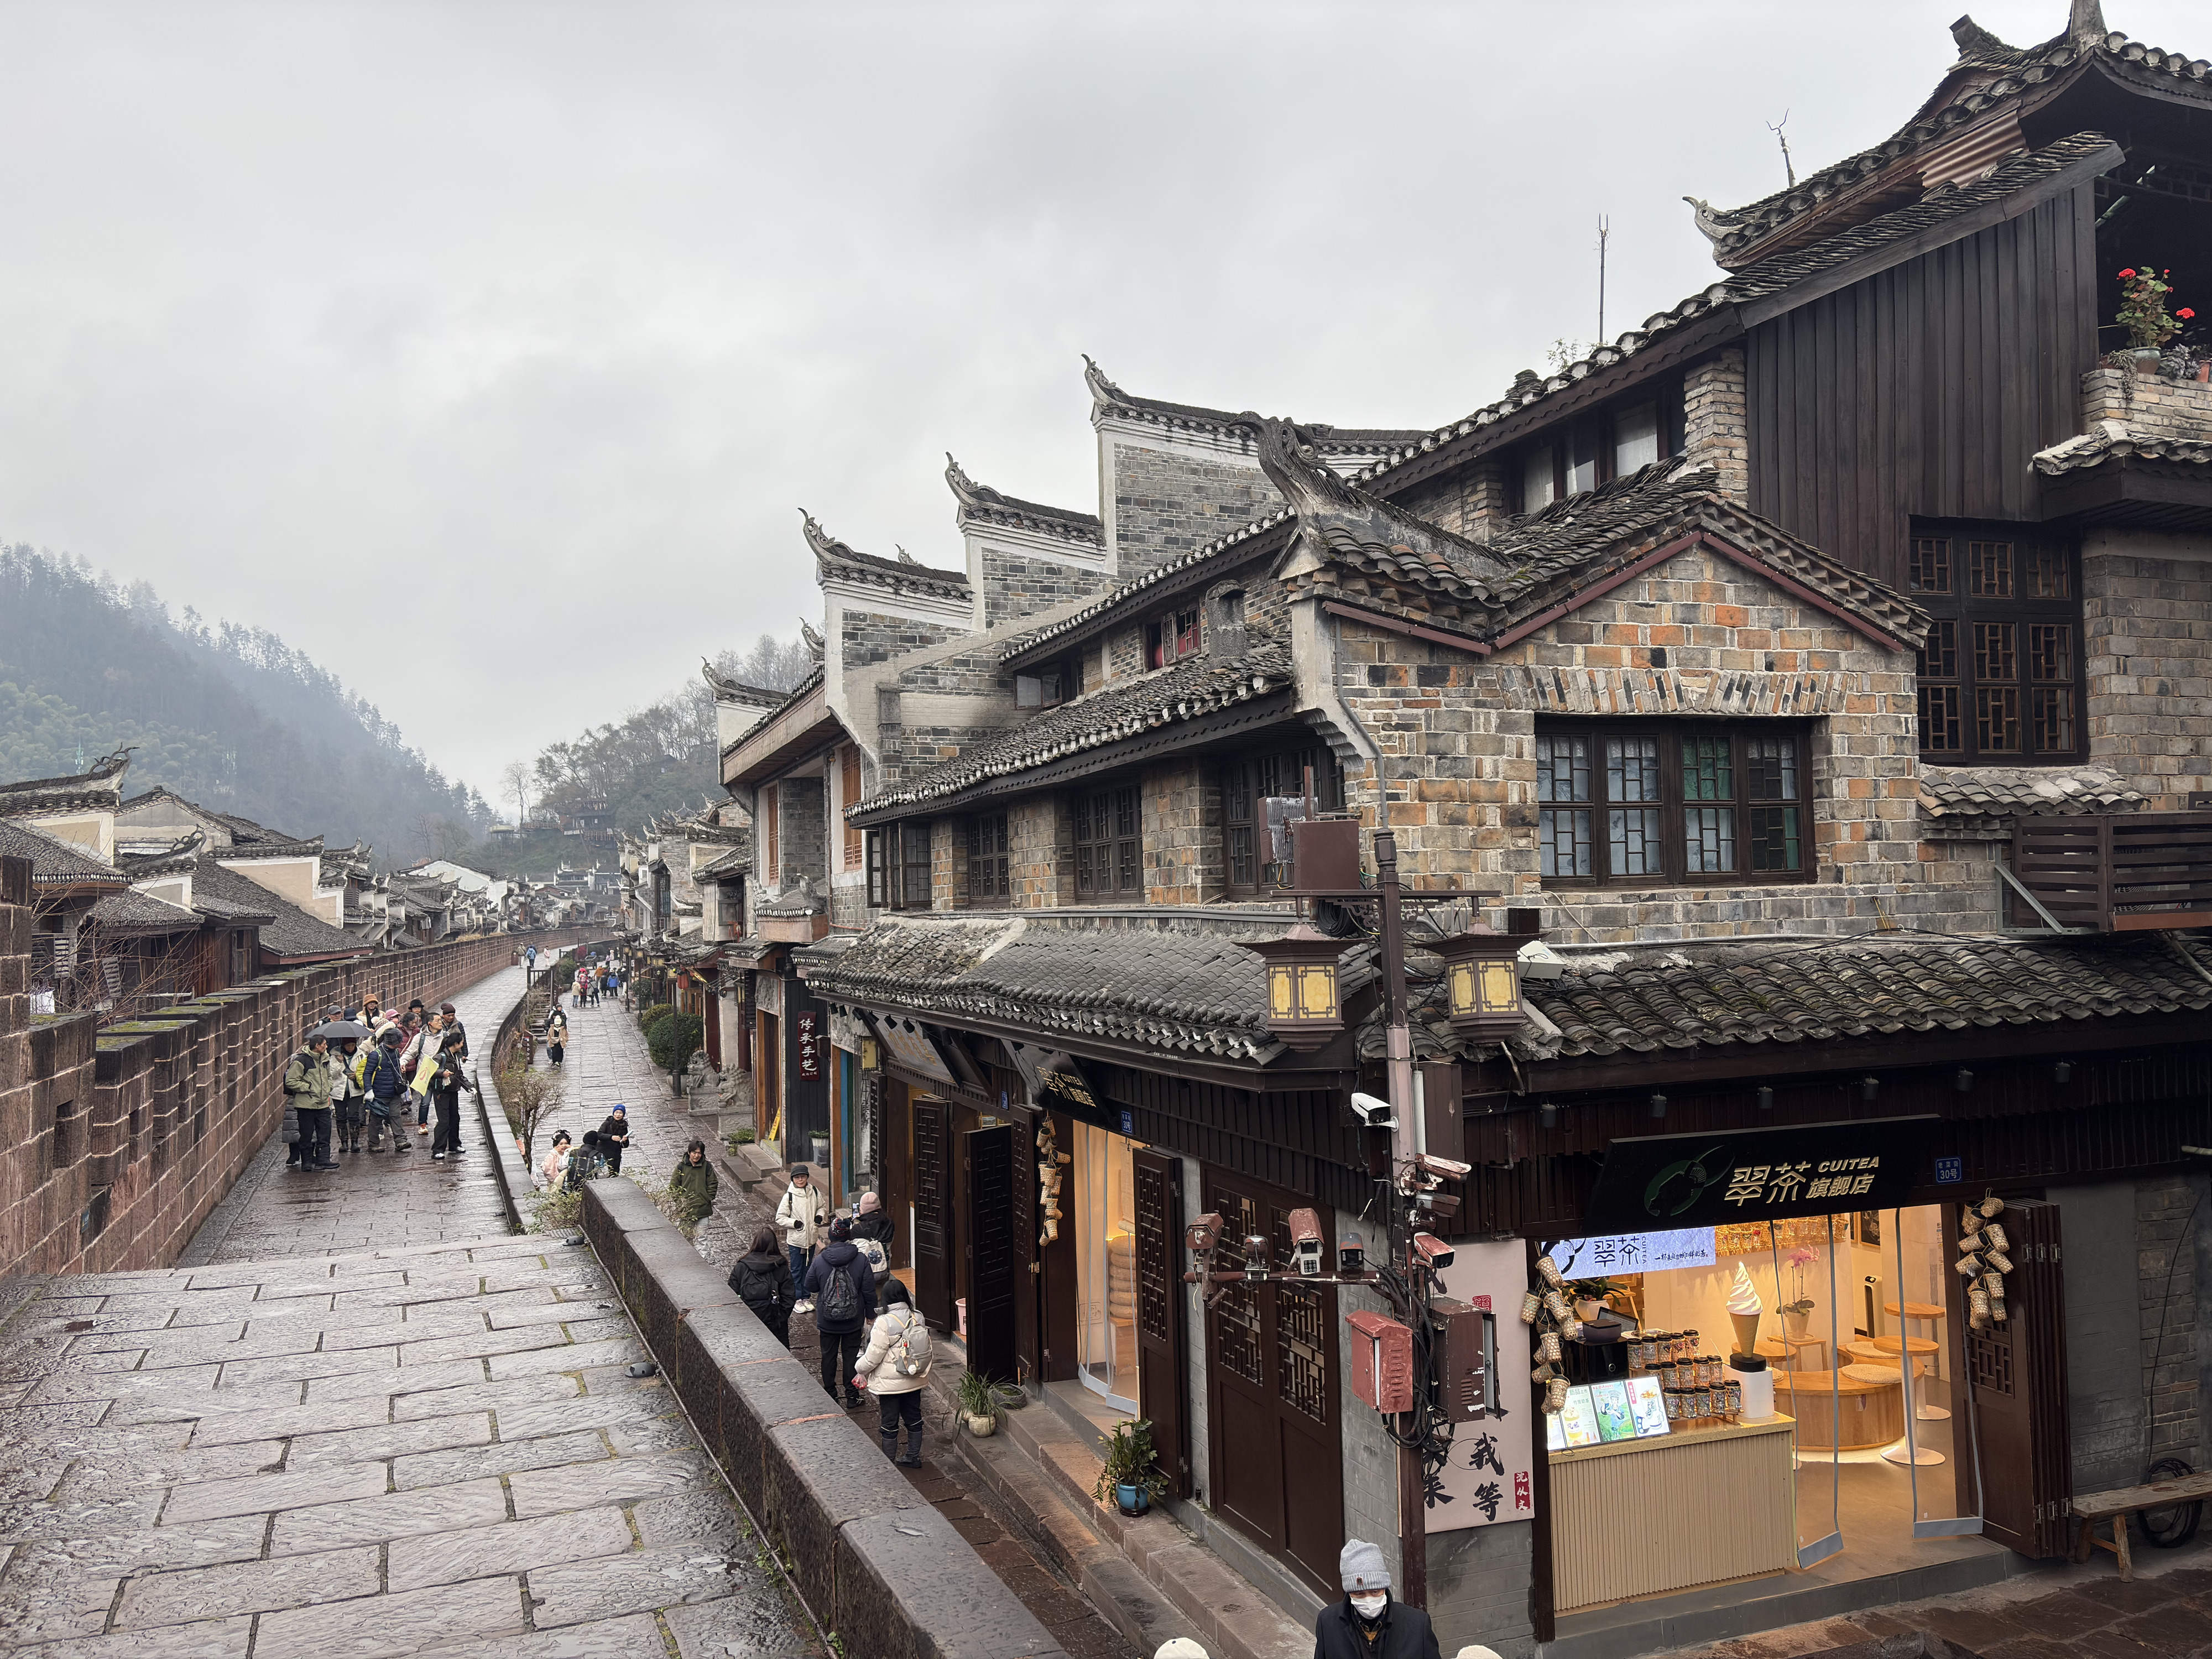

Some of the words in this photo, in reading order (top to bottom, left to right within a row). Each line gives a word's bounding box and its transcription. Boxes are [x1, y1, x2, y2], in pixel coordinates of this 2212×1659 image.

[799, 1018, 817, 1071] 传承手艺
[1036, 1066, 1074, 1101] 翠茶
[1060, 1073, 1084, 1087] CUITEA
[1818, 1156, 1879, 1172] CUITEA
[1940, 1168, 1958, 1179] 30号
[1724, 1160, 1811, 1206] 翠茶
[1806, 1173, 1875, 1199] 旗舰店
[1594, 1236, 1640, 1267] 翠茶
[1516, 1472, 1528, 1510] 沈从文
